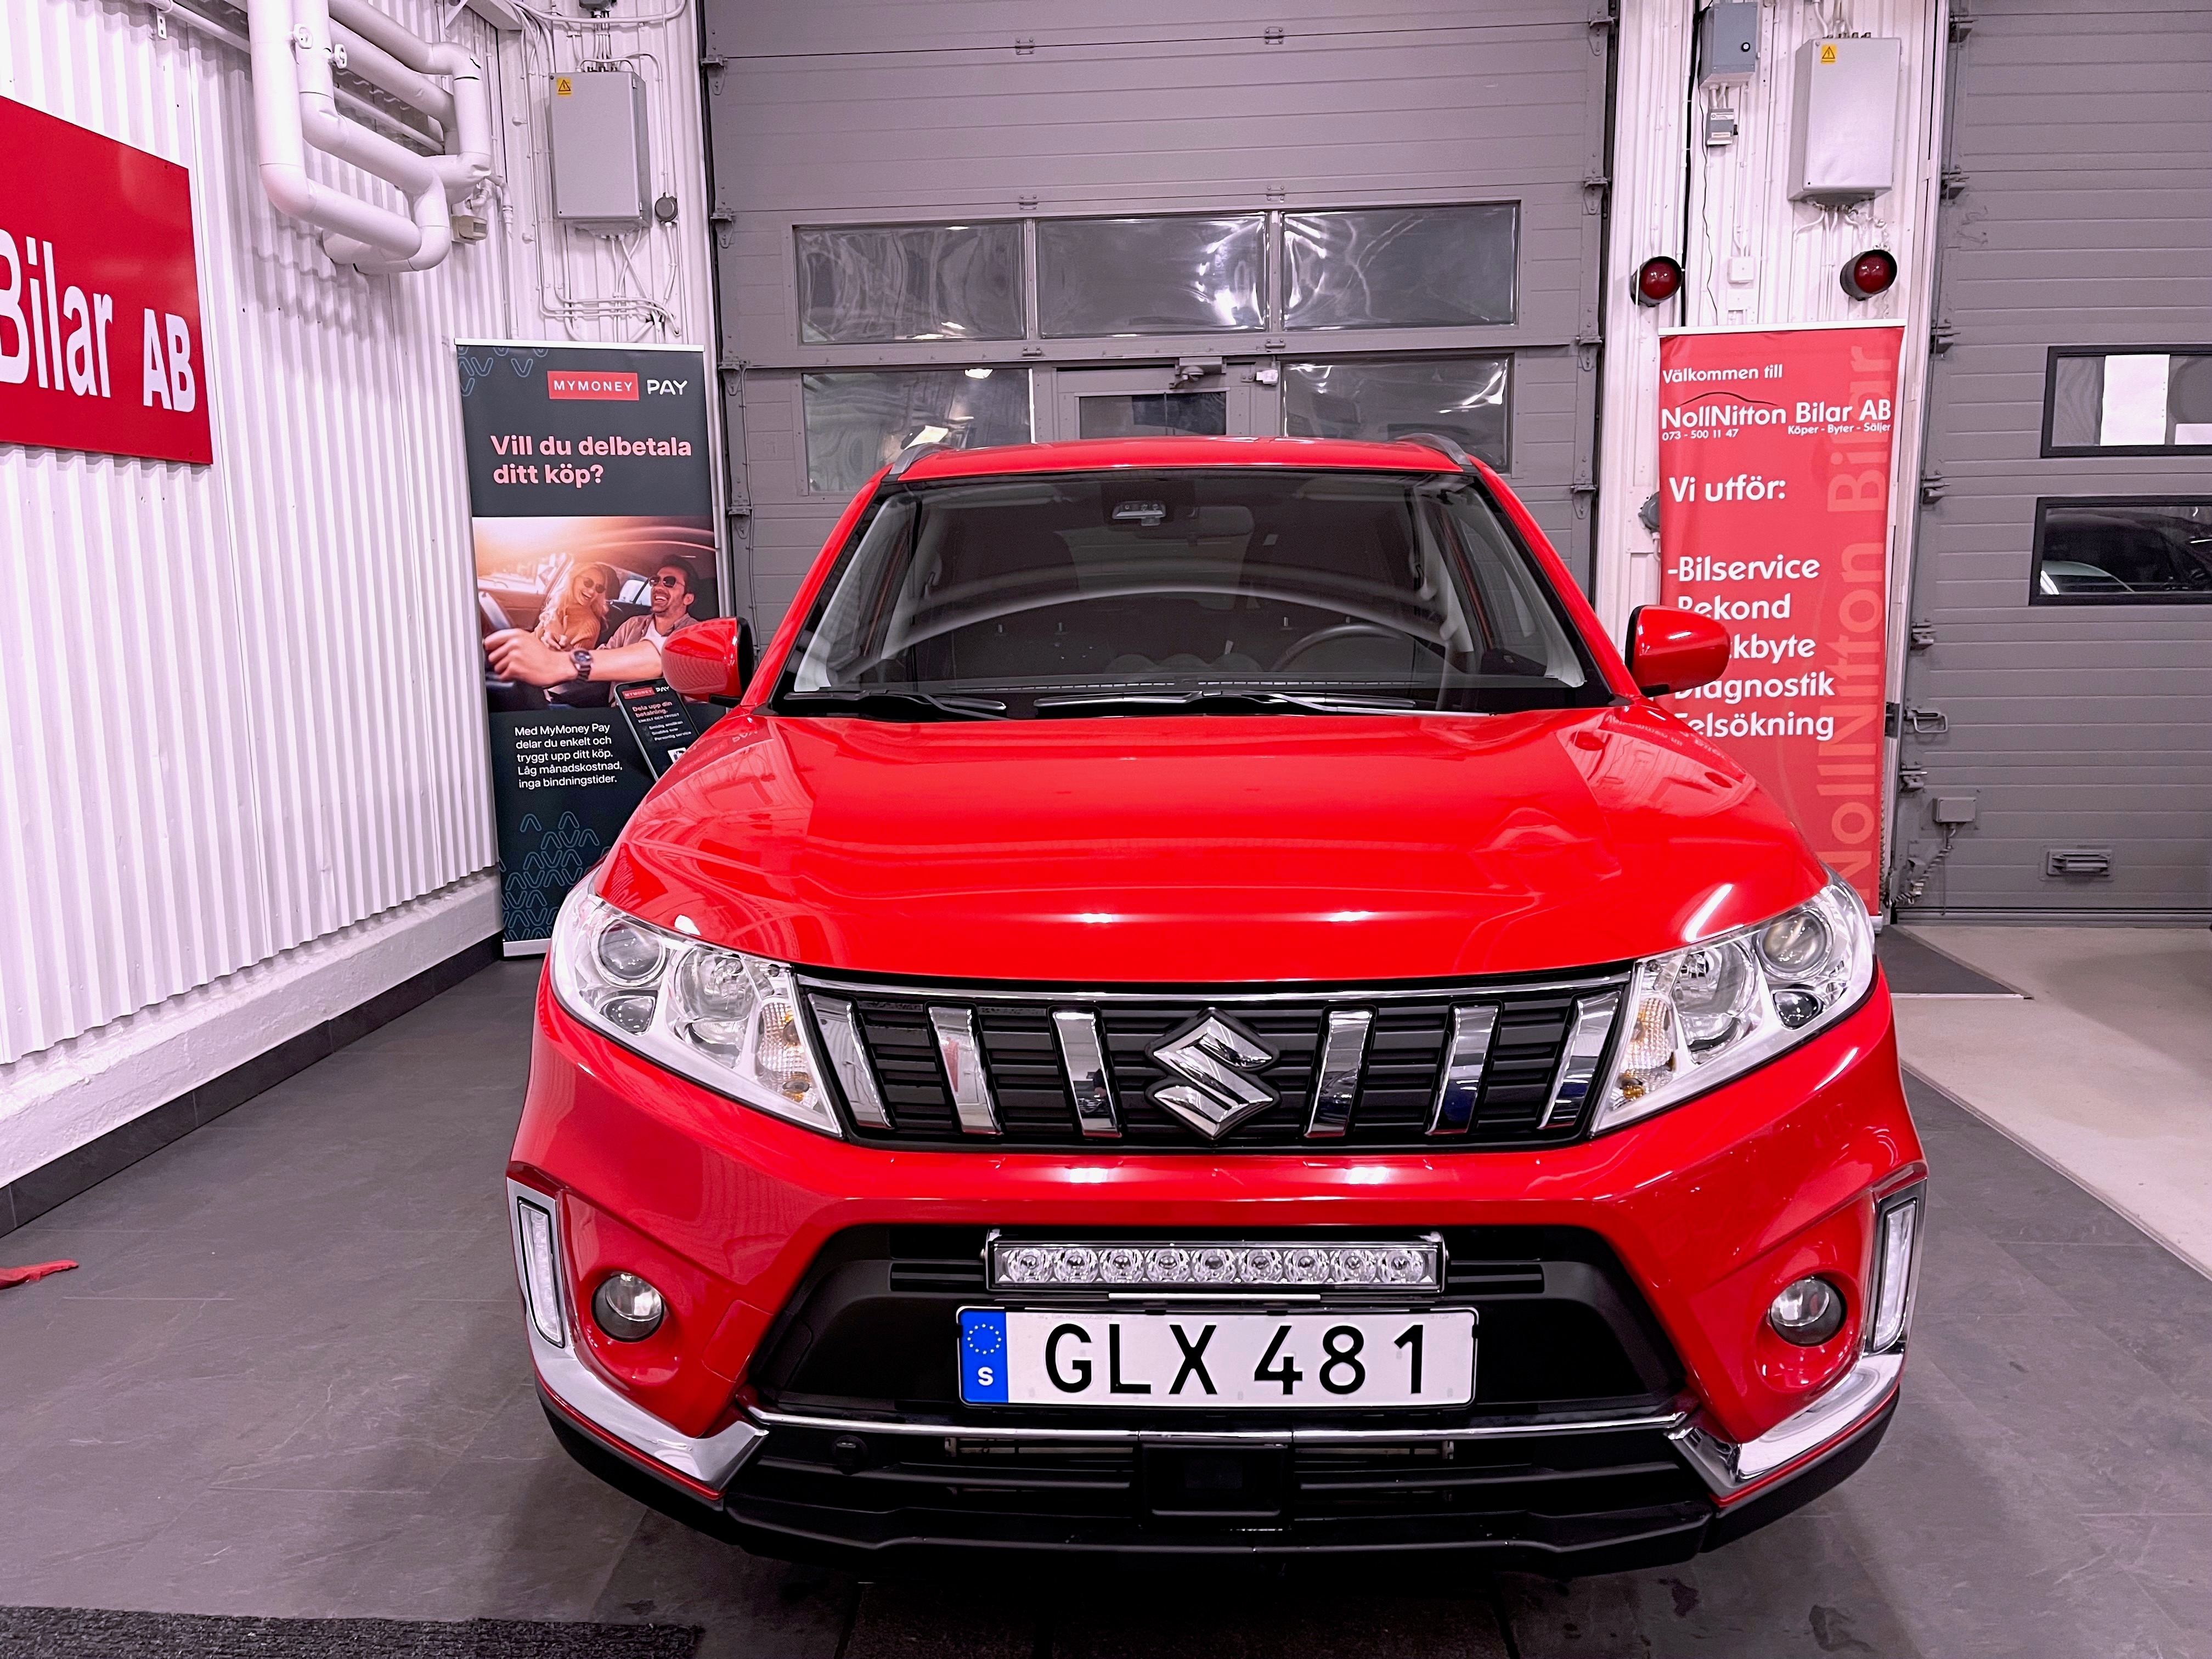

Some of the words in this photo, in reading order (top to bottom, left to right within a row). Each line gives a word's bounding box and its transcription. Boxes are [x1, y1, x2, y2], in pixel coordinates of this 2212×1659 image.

[0, 229, 113, 398] Bilar
[143, 308, 196, 413] AB
[1662, 366, 1759, 383] Välkommen
[1764, 364, 1783, 379] till
[554, 380, 633, 392] MYMONEY
[647, 380, 688, 395] PAY
[1661, 405, 1786, 430] NollNitton
[1796, 401, 1853, 424] Bilar
[1859, 399, 1891, 421] AB
[1662, 431, 1681, 441] 073
[1691, 430, 1709, 438] 500
[1713, 429, 1721, 438] 11
[1725, 428, 1740, 437] 47
[1787, 425, 1819, 436] Köper
[1827, 424, 1855, 435] Byter
[1863, 422, 1891, 433] Säljer
[1827, 346, 1892, 512] Bilar
[490, 435, 533, 455] Vill
[539, 436, 572, 455] du
[578, 436, 692, 456] delbetala
[493, 464, 539, 483] ditt
[545, 464, 603, 488] köp?
[1668, 476, 1696, 502] Vi
[1705, 474, 1786, 501] utför:
[1667, 555, 1820, 582] -Bilservice
[1729, 633, 1816, 664] kbyte
[515, 726, 538, 736] Med
[540, 725, 590, 737] MyMoney
[591, 724, 611, 733] Pay
[516, 740, 542, 749] delar
[544, 739, 558, 748] du
[560, 737, 591, 747] enkelt
[592, 736, 612, 745] och
[517, 752, 549, 764] tryggt
[550, 753, 571, 762] upp
[573, 749, 590, 759] ditt
[592, 748, 613, 759] köp.
[518, 766, 537, 777] Låg
[539, 761, 623, 774] månadskostnad,
[518, 780, 541, 790] inga
[543, 775, 617, 787] bindningstider.
[1045, 1323, 1218, 1395] GLX
[1254, 1324, 1424, 1395] 481
[978, 1367, 993, 1386] S
